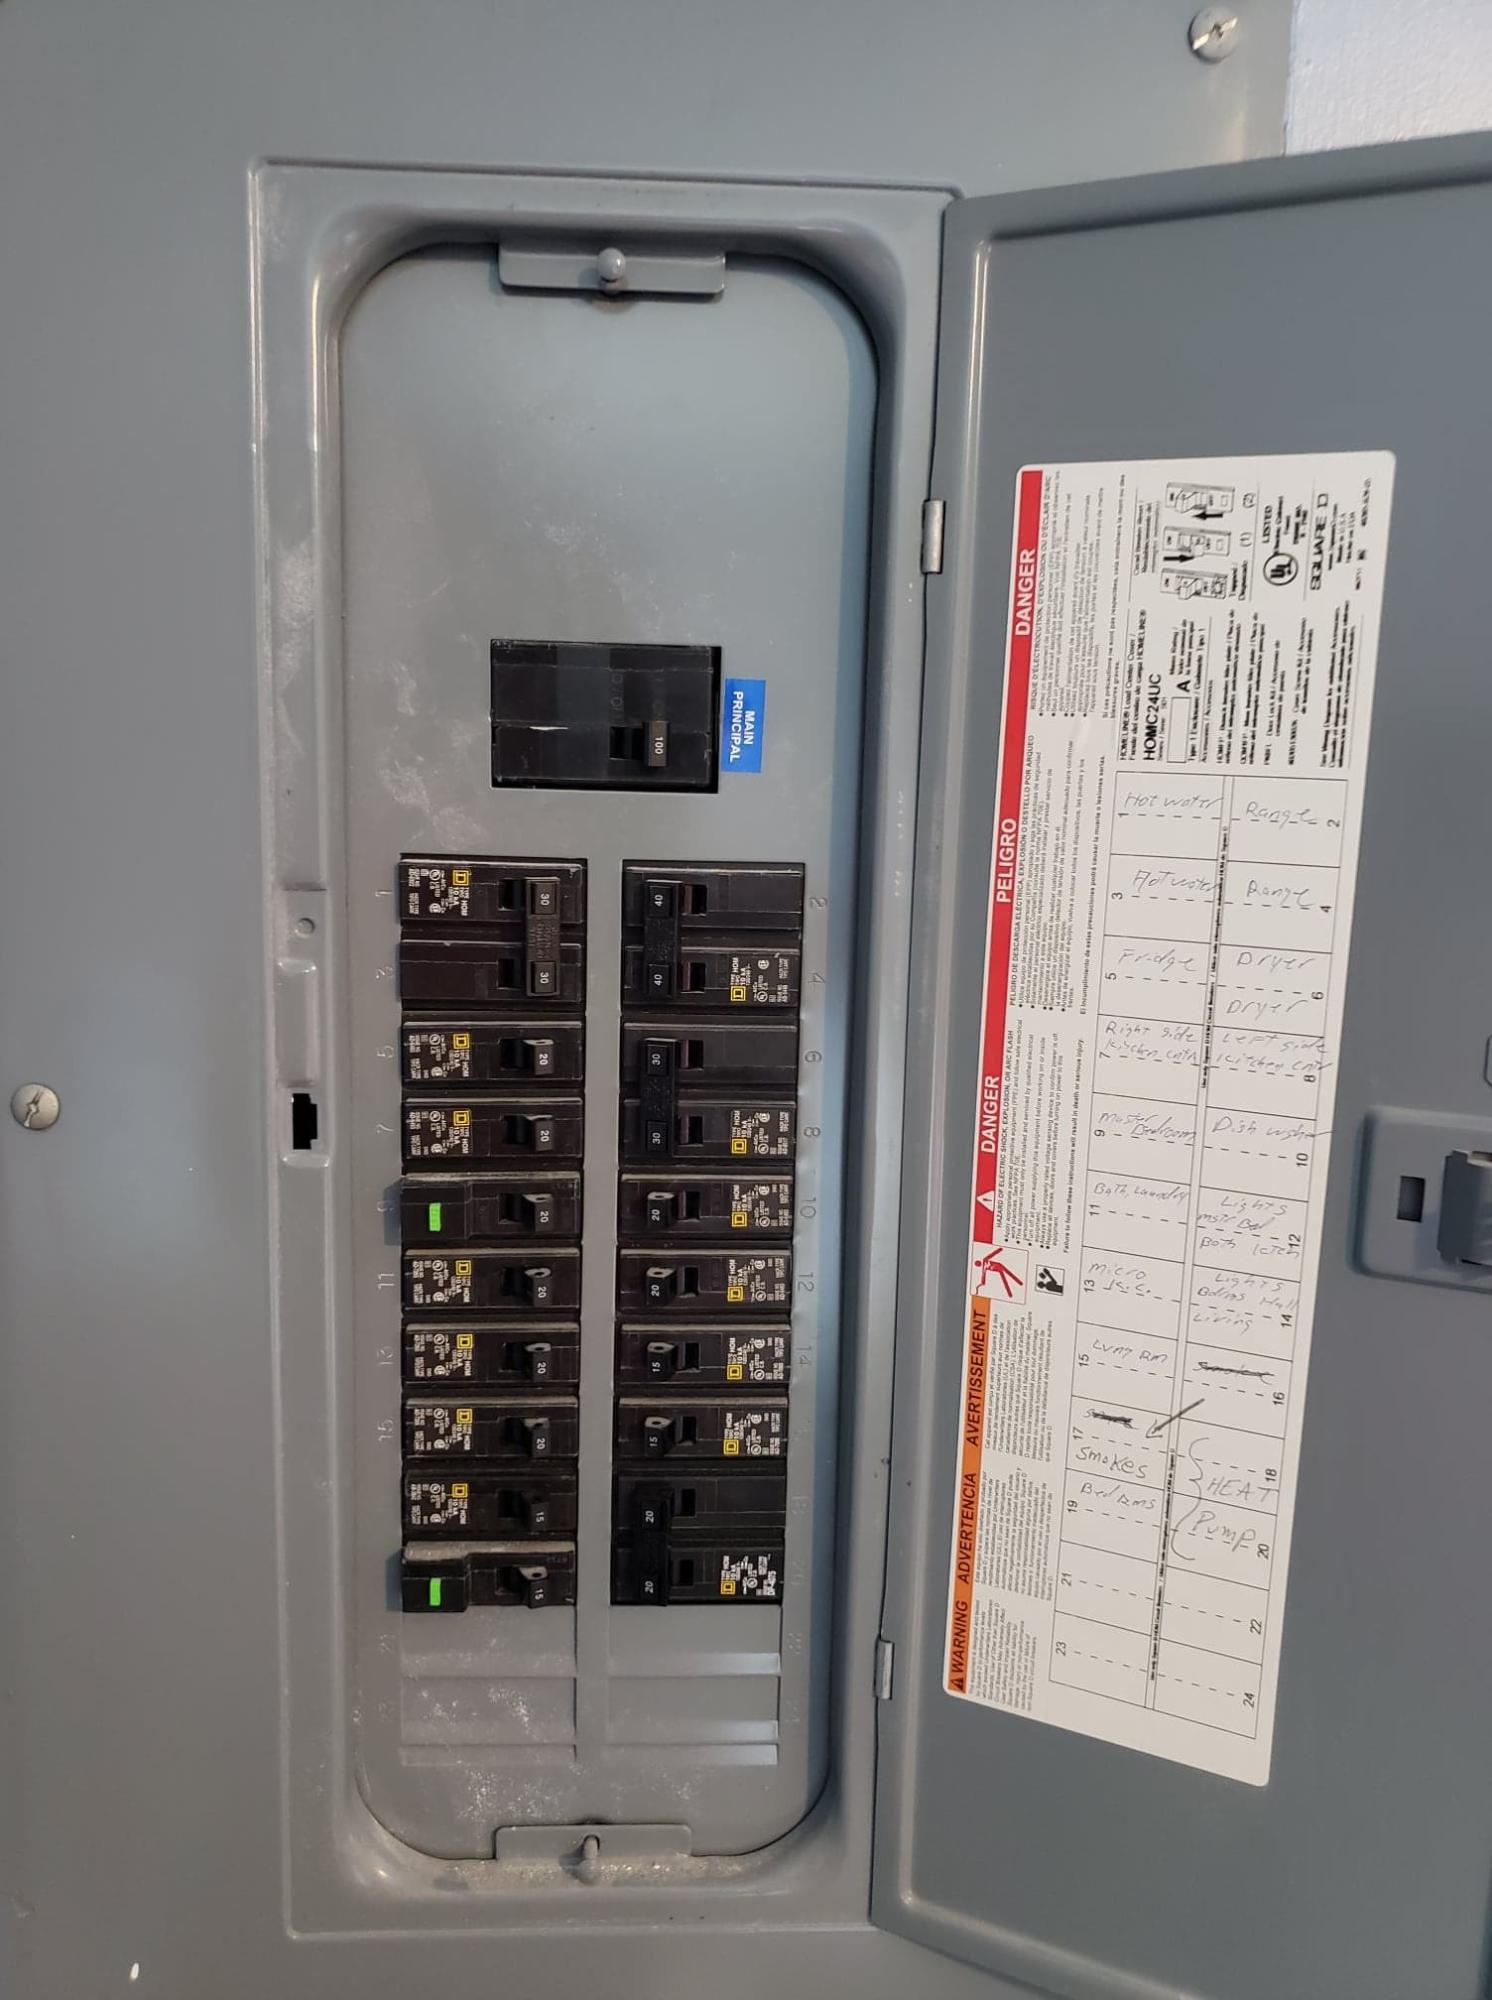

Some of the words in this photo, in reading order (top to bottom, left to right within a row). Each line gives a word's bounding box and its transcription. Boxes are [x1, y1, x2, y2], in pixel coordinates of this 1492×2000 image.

[1316, 494, 1329, 508] D
[1261, 505, 1273, 544] LISTED
[1310, 516, 1328, 591] SQUARE
[1014, 548, 1036, 636] DANGER
[1177, 680, 1190, 692] A
[1143, 673, 1161, 761] HOMC24UC
[729, 690, 743, 763] PRINCIPAL
[743, 710, 755, 746] MAIN
[654, 736, 664, 755] 100
[1025, 735, 1034, 767] ARQUEO
[1024, 770, 1032, 784] POR
[1022, 786, 1030, 824] DESTELLO
[1246, 801, 1317, 829] Range
[1326, 819, 1339, 828] 2
[995, 818, 1017, 904] PELIGRO
[540, 893, 550, 906] 30
[654, 894, 663, 907] 40
[1012, 922, 1020, 962] DESCARGA
[1119, 948, 1198, 972] Fridge
[540, 972, 549, 984] 30
[654, 974, 663, 986] 40
[1105, 973, 1116, 981] 5
[1010, 974, 1018, 1006] PELIGRO
[1312, 992, 1323, 1000] 6
[539, 1053, 549, 1066] 20
[651, 1053, 661, 1066] 30
[1303, 1075, 1316, 1083] 8
[980, 1076, 999, 1154] DANGER
[540, 1130, 550, 1142] 20
[803, 1126, 821, 1138] 8
[996, 1201, 1004, 1228] HAZARD
[1006, 1030, 1014, 1053] FLASH
[652, 1132, 661, 1145] 30
[1296, 1153, 1308, 1167] 10
[651, 1209, 660, 1221] 20
[800, 1197, 817, 1219] 10
[1089, 1204, 1100, 1216] 11
[540, 1210, 549, 1223] 20
[1288, 1234, 1301, 1248] 12
[797, 1273, 814, 1293] 12
[1084, 1279, 1095, 1293] 13
[537, 1286, 547, 1298] 20
[651, 1284, 660, 1297] 20
[1281, 1314, 1291, 1328] 14
[795, 1345, 813, 1367] 14
[1078, 1354, 1089, 1367] 15
[537, 1362, 547, 1374] 20
[651, 1361, 661, 1372] 15
[966, 1309, 986, 1446] AVERTISSEMENT
[1273, 1392, 1285, 1406] 16
[1073, 1427, 1084, 1440] 17
[536, 1437, 546, 1450] 20
[649, 1436, 658, 1447] 15
[1265, 1468, 1277, 1482] 18
[1207, 1477, 1280, 1502] HEAT
[1067, 1500, 1078, 1514] 19
[536, 1511, 545, 1523] 15
[645, 1510, 655, 1523] 20
[957, 1473, 977, 1585] ADVERTENCIA
[1257, 1544, 1270, 1559] 20
[1061, 1572, 1072, 1586] 21
[534, 1588, 544, 1600] 15
[644, 1580, 654, 1594] 20
[1250, 1619, 1262, 1634] 22
[951, 1600, 968, 1674] WARNING
[1055, 1641, 1067, 1656] 23
[1243, 1692, 1256, 1708] 24
